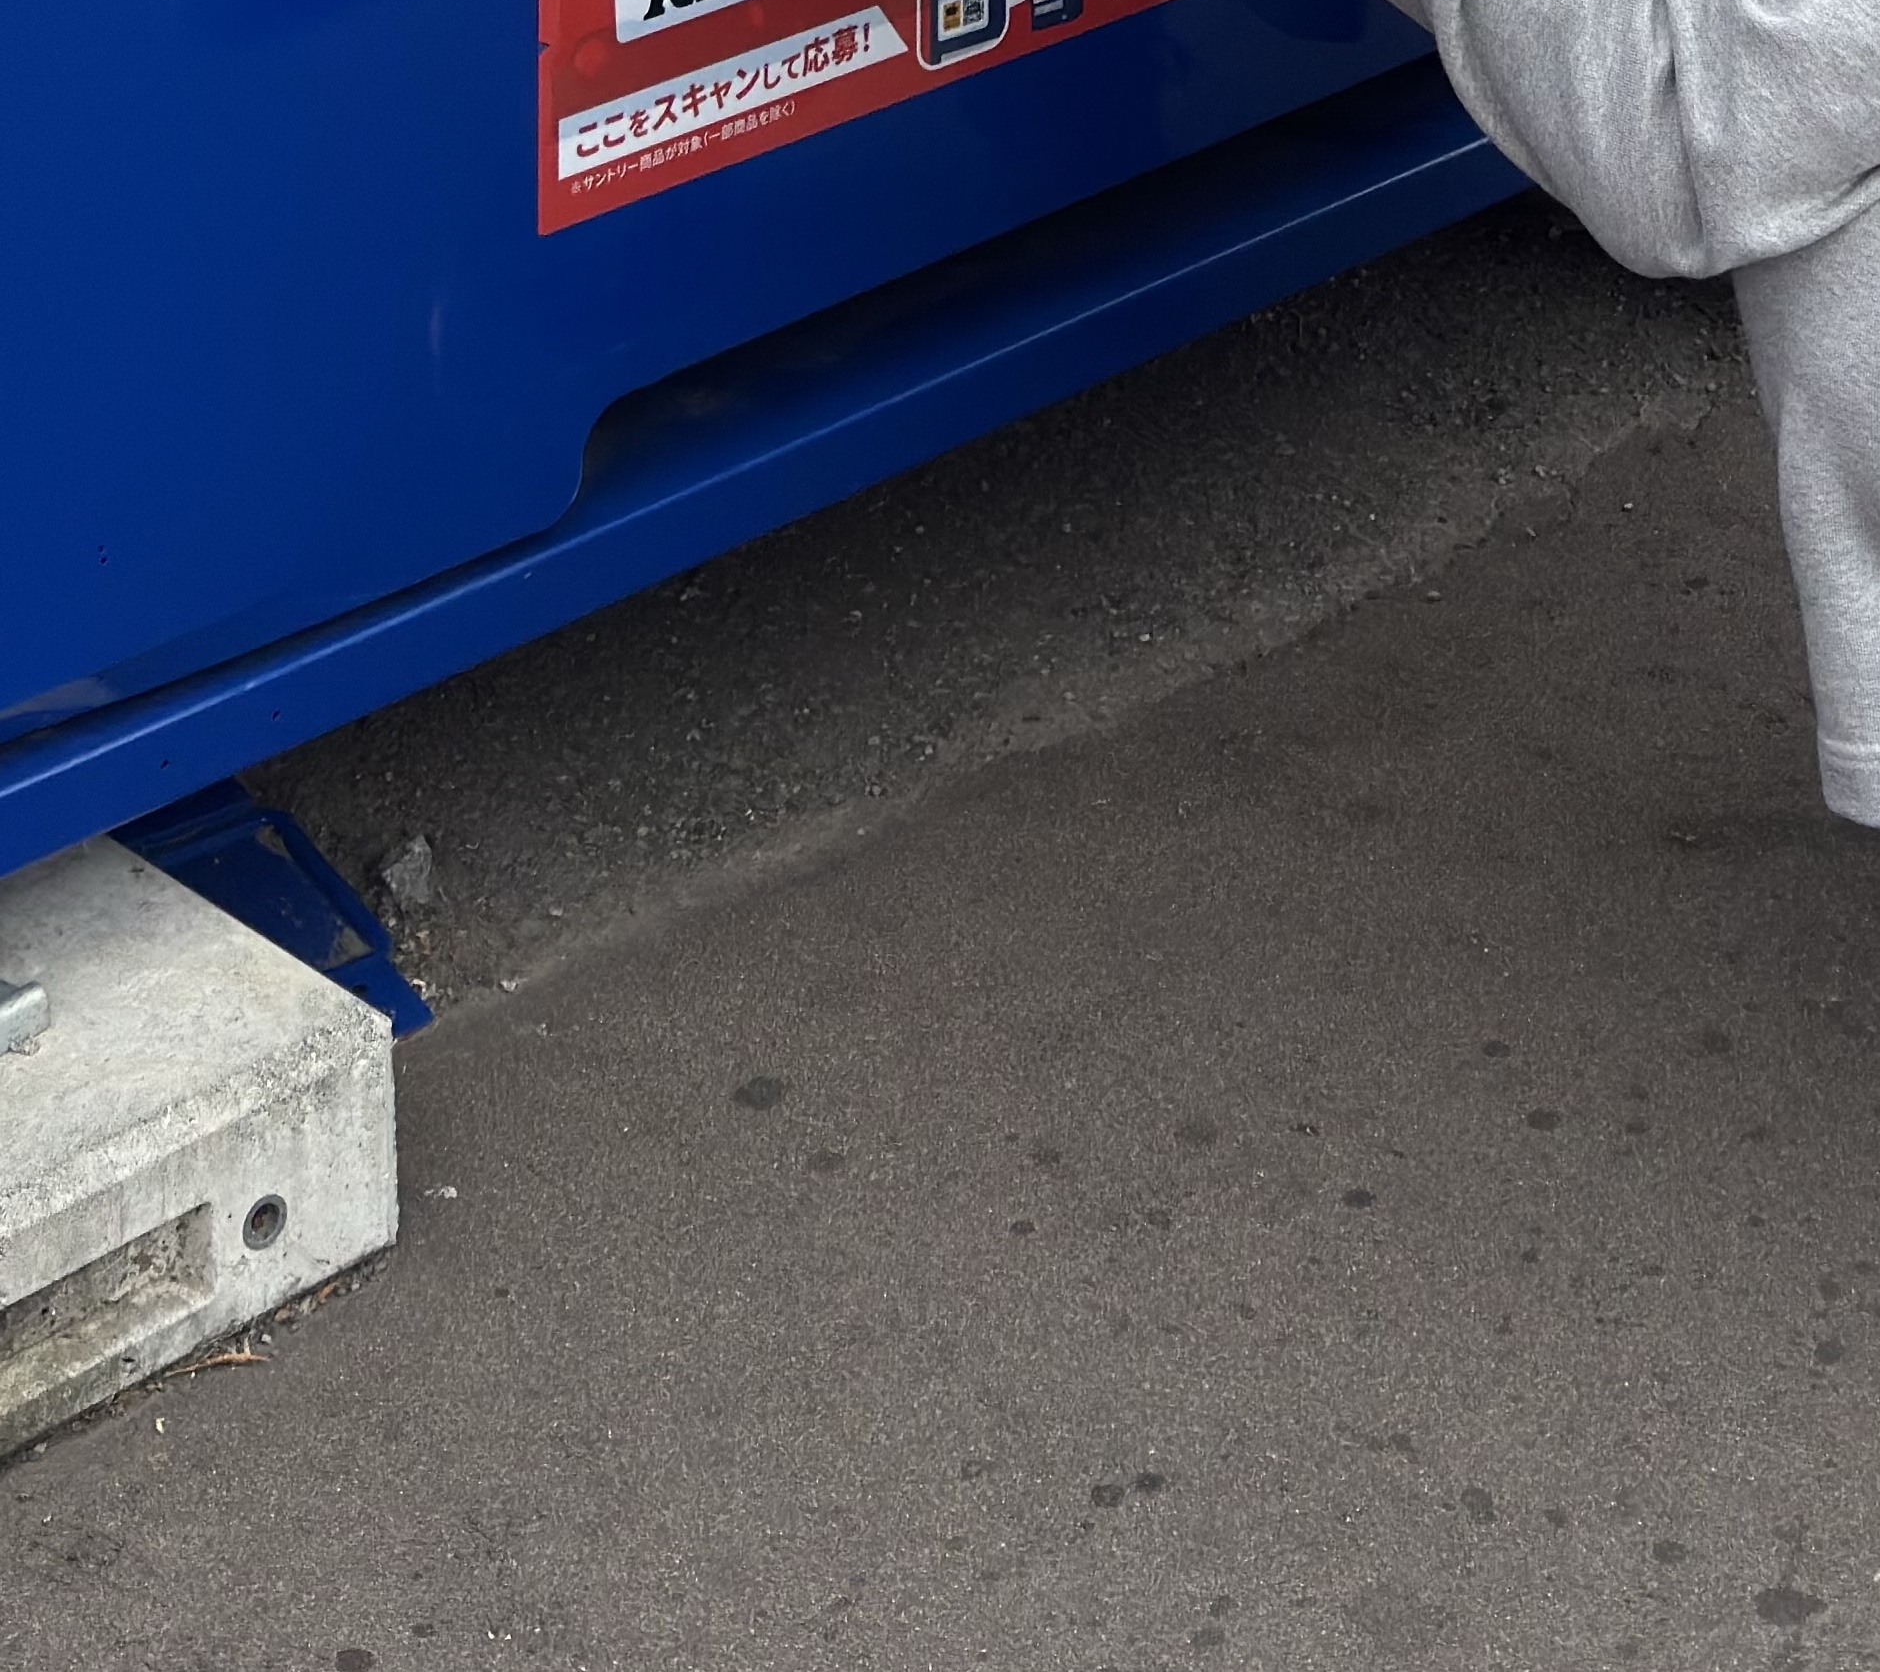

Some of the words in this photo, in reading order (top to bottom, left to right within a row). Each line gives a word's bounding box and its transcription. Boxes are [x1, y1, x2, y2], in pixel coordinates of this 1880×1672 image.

[577, 23, 871, 157] ここをスキャンして応募!
